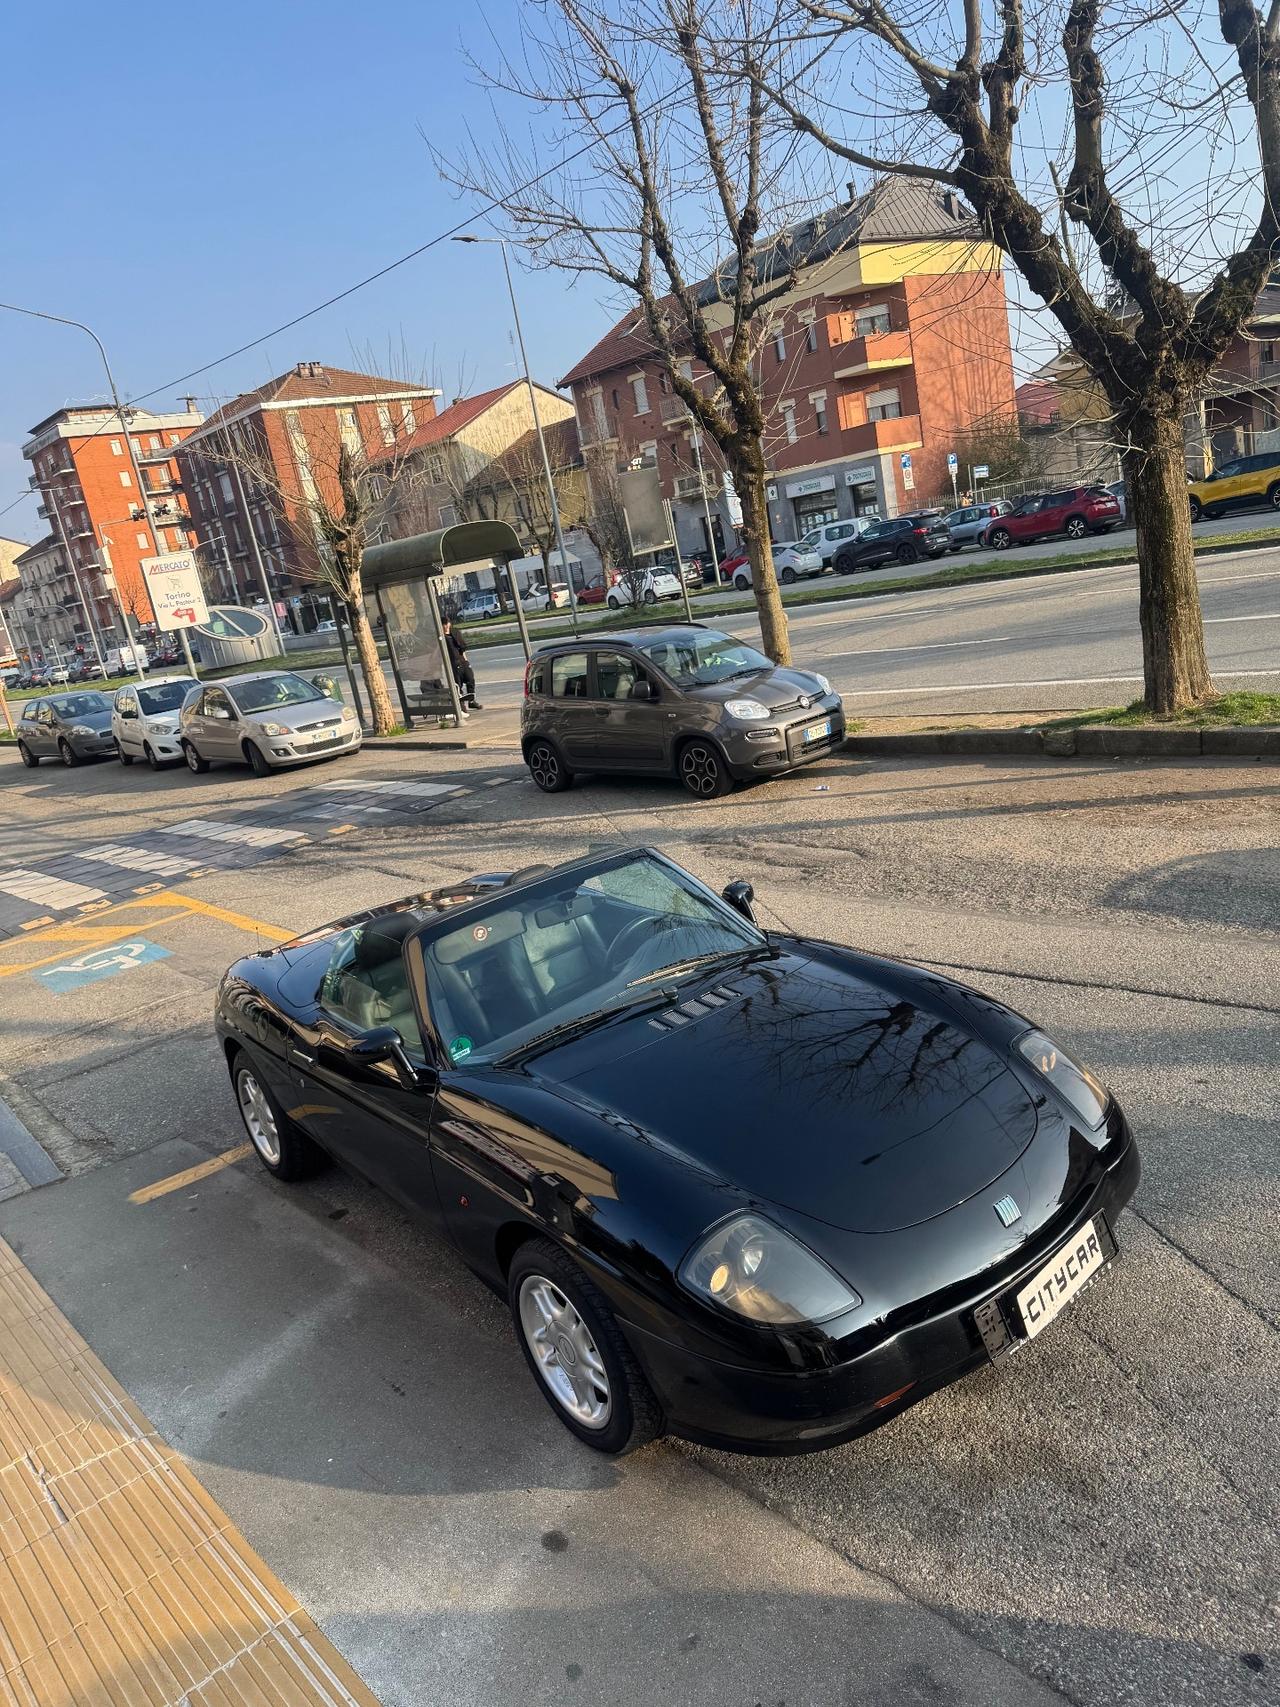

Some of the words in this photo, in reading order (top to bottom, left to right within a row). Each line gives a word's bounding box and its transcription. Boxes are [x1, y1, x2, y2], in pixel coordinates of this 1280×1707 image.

[149, 560, 190, 575] MERCATO
[165, 591, 191, 600] Torino
[1026, 1233, 1099, 1323] CITYCAR
